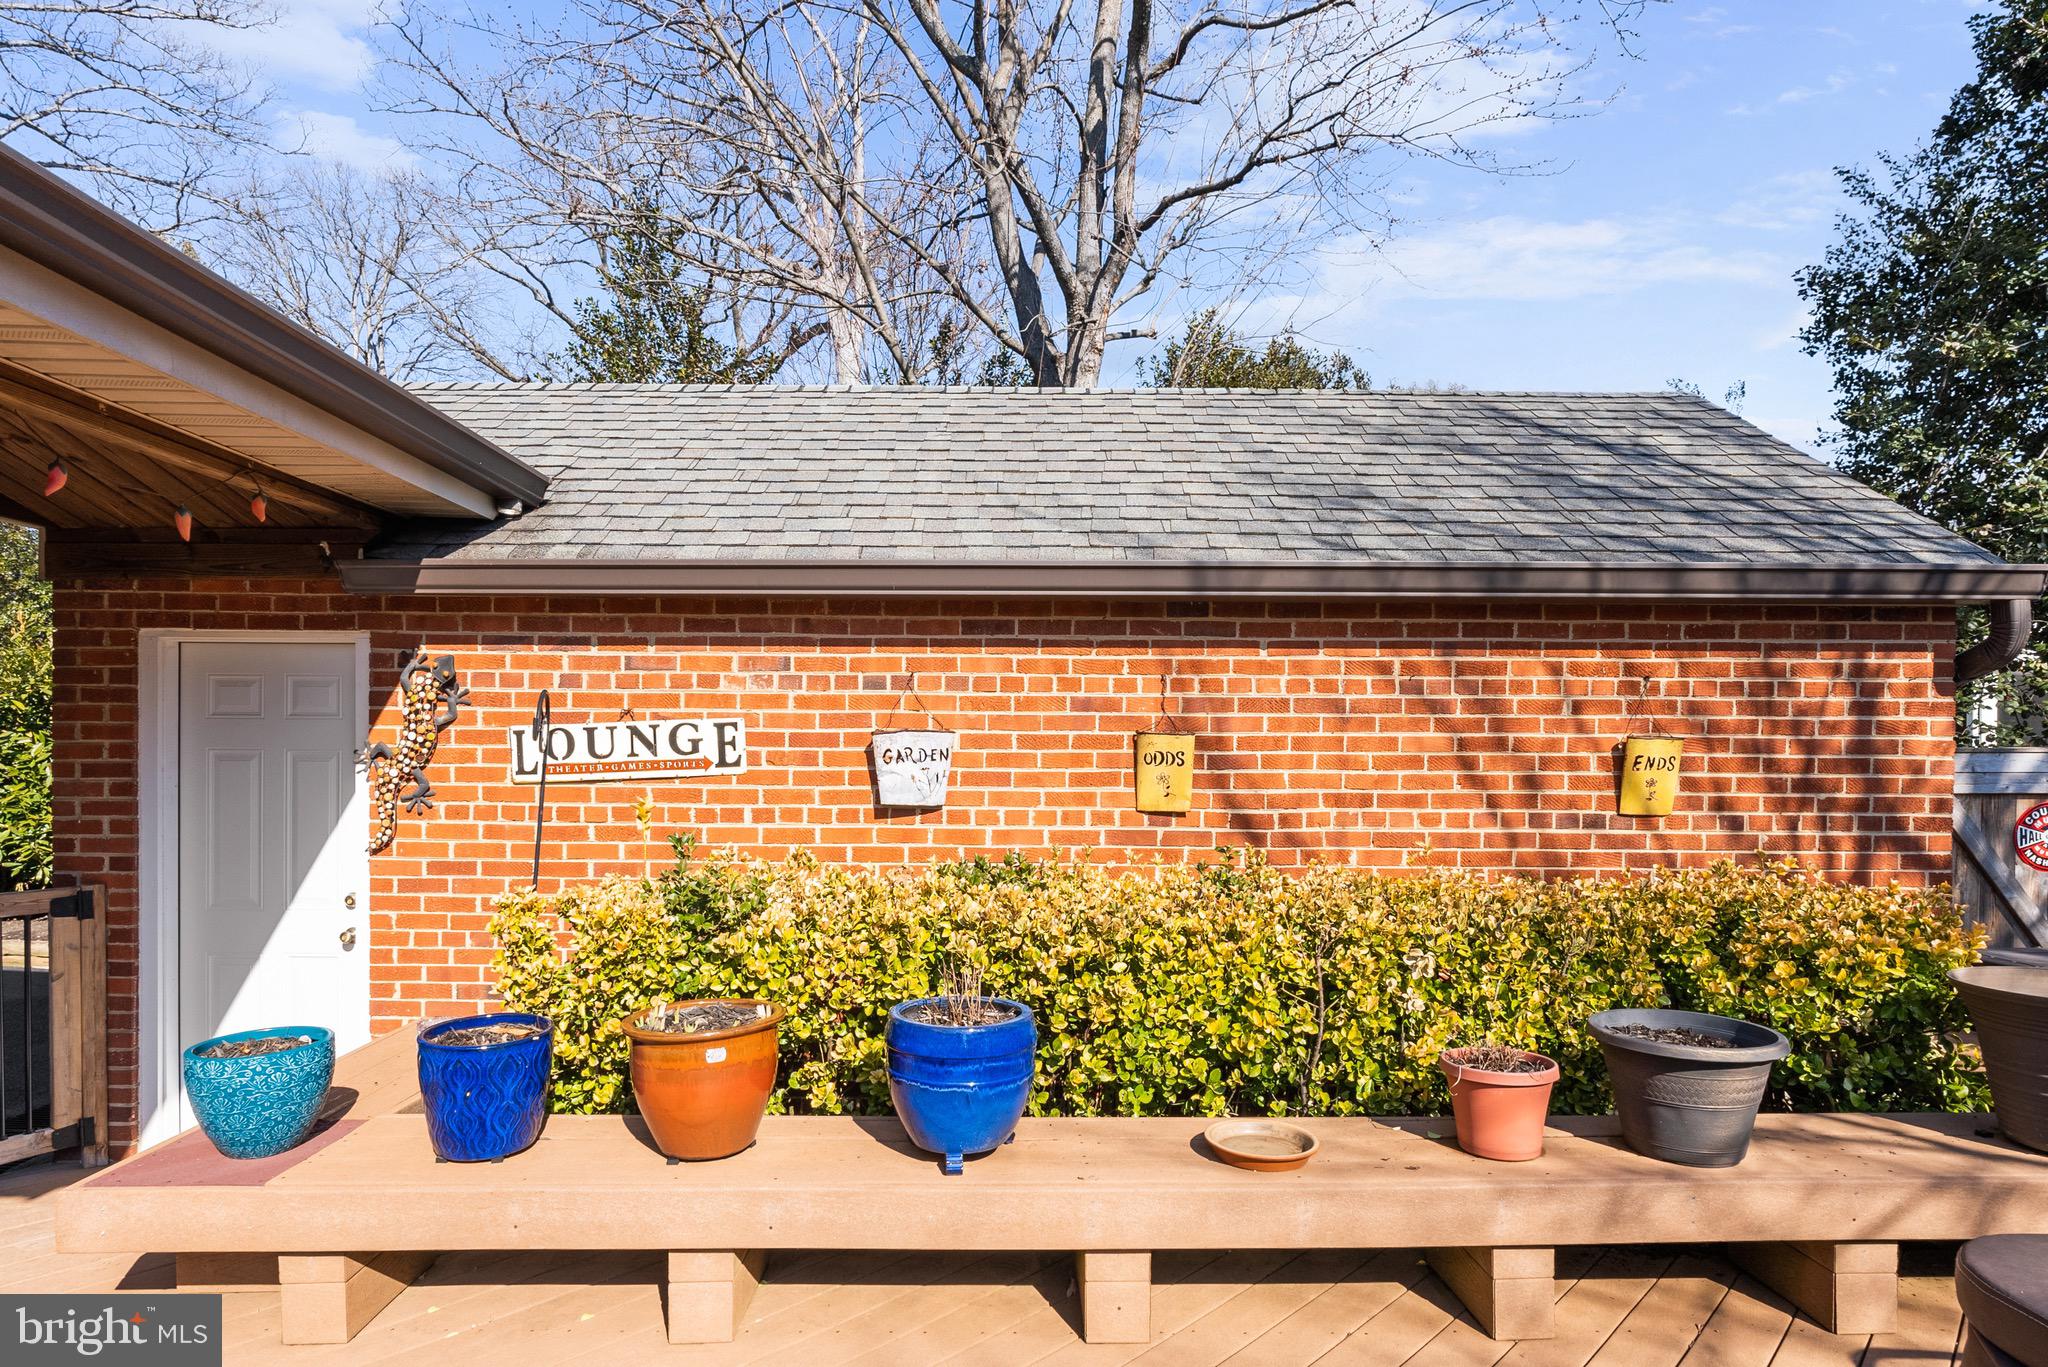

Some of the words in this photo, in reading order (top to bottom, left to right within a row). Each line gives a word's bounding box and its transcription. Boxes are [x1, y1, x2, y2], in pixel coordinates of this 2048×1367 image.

[512, 722, 742, 775] LOUNGE
[882, 747, 949, 765] GARDEN
[548, 763, 604, 773] THEATER
[611, 761, 654, 771] GAMES
[659, 760, 705, 769] SPORTS
[1143, 750, 1185, 767] ODDS
[1632, 755, 1676, 771] ENDS
